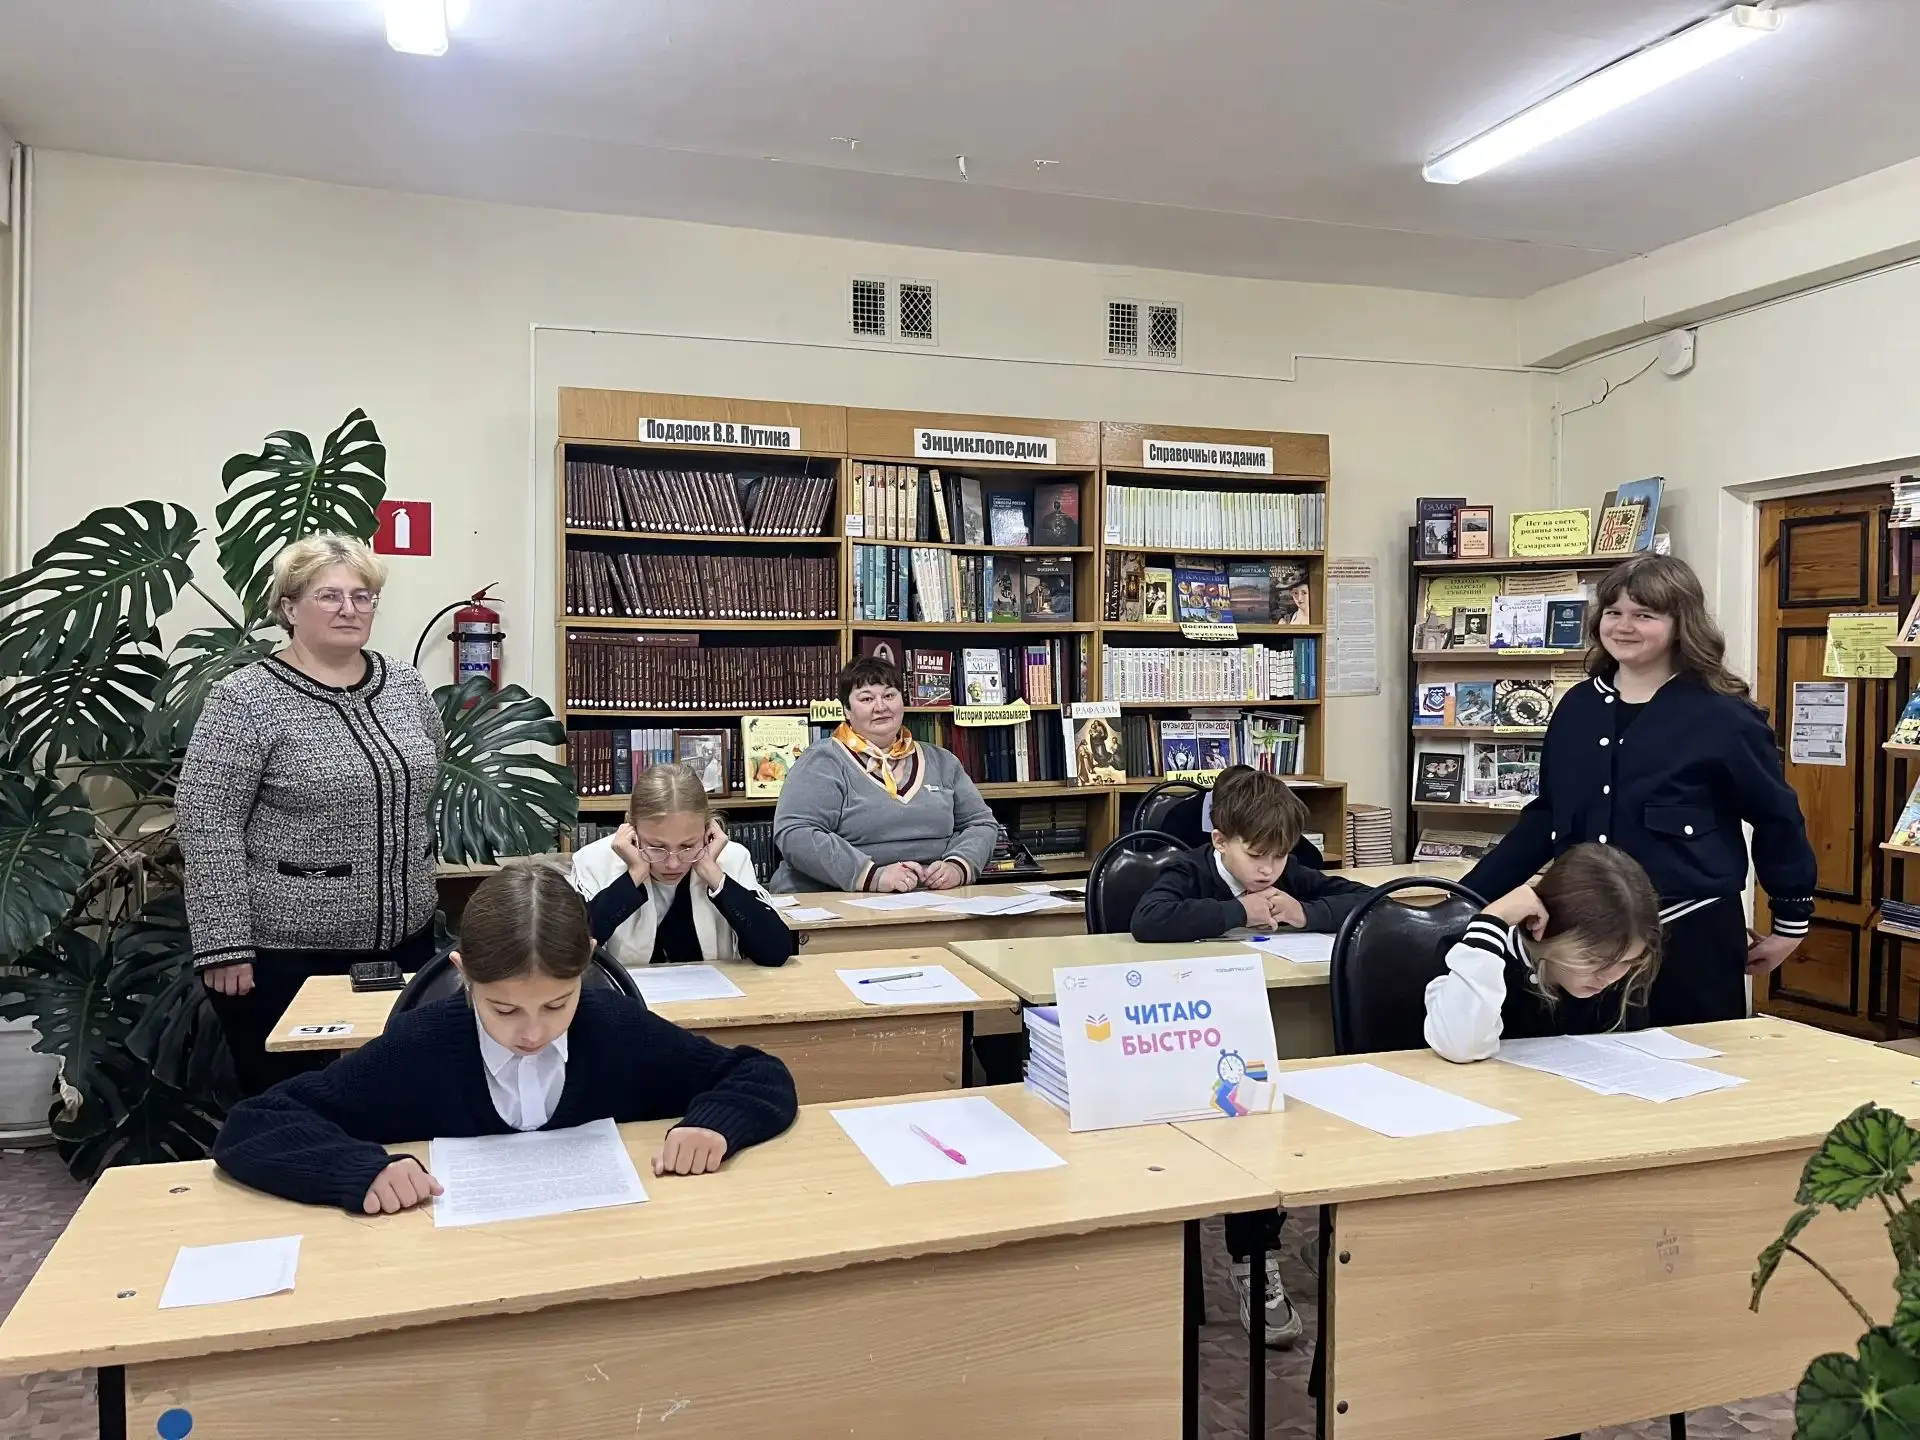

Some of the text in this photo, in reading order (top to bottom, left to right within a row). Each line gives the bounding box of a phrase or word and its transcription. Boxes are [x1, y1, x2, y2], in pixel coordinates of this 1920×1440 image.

[646, 419, 791, 447] Подарок В.В. Путина
[921, 432, 1048, 459] Энциклопедии
[1149, 443, 1266, 468] Справочные издания
[1423, 503, 1457, 511] САМАР
[917, 655, 944, 666] КРЫМ
[972, 662, 994, 671] МИР
[811, 704, 844, 719] ПОЧЕ
[955, 708, 1029, 724] История рассказывает
[1075, 705, 1118, 715] РАФАЭЛЬ
[1180, 722, 1195, 730] 2023
[1215, 722, 1230, 730] 2024
[1124, 999, 1212, 1025] ЧИТАЮ
[1121, 1027, 1222, 1056] БЫСТРО
